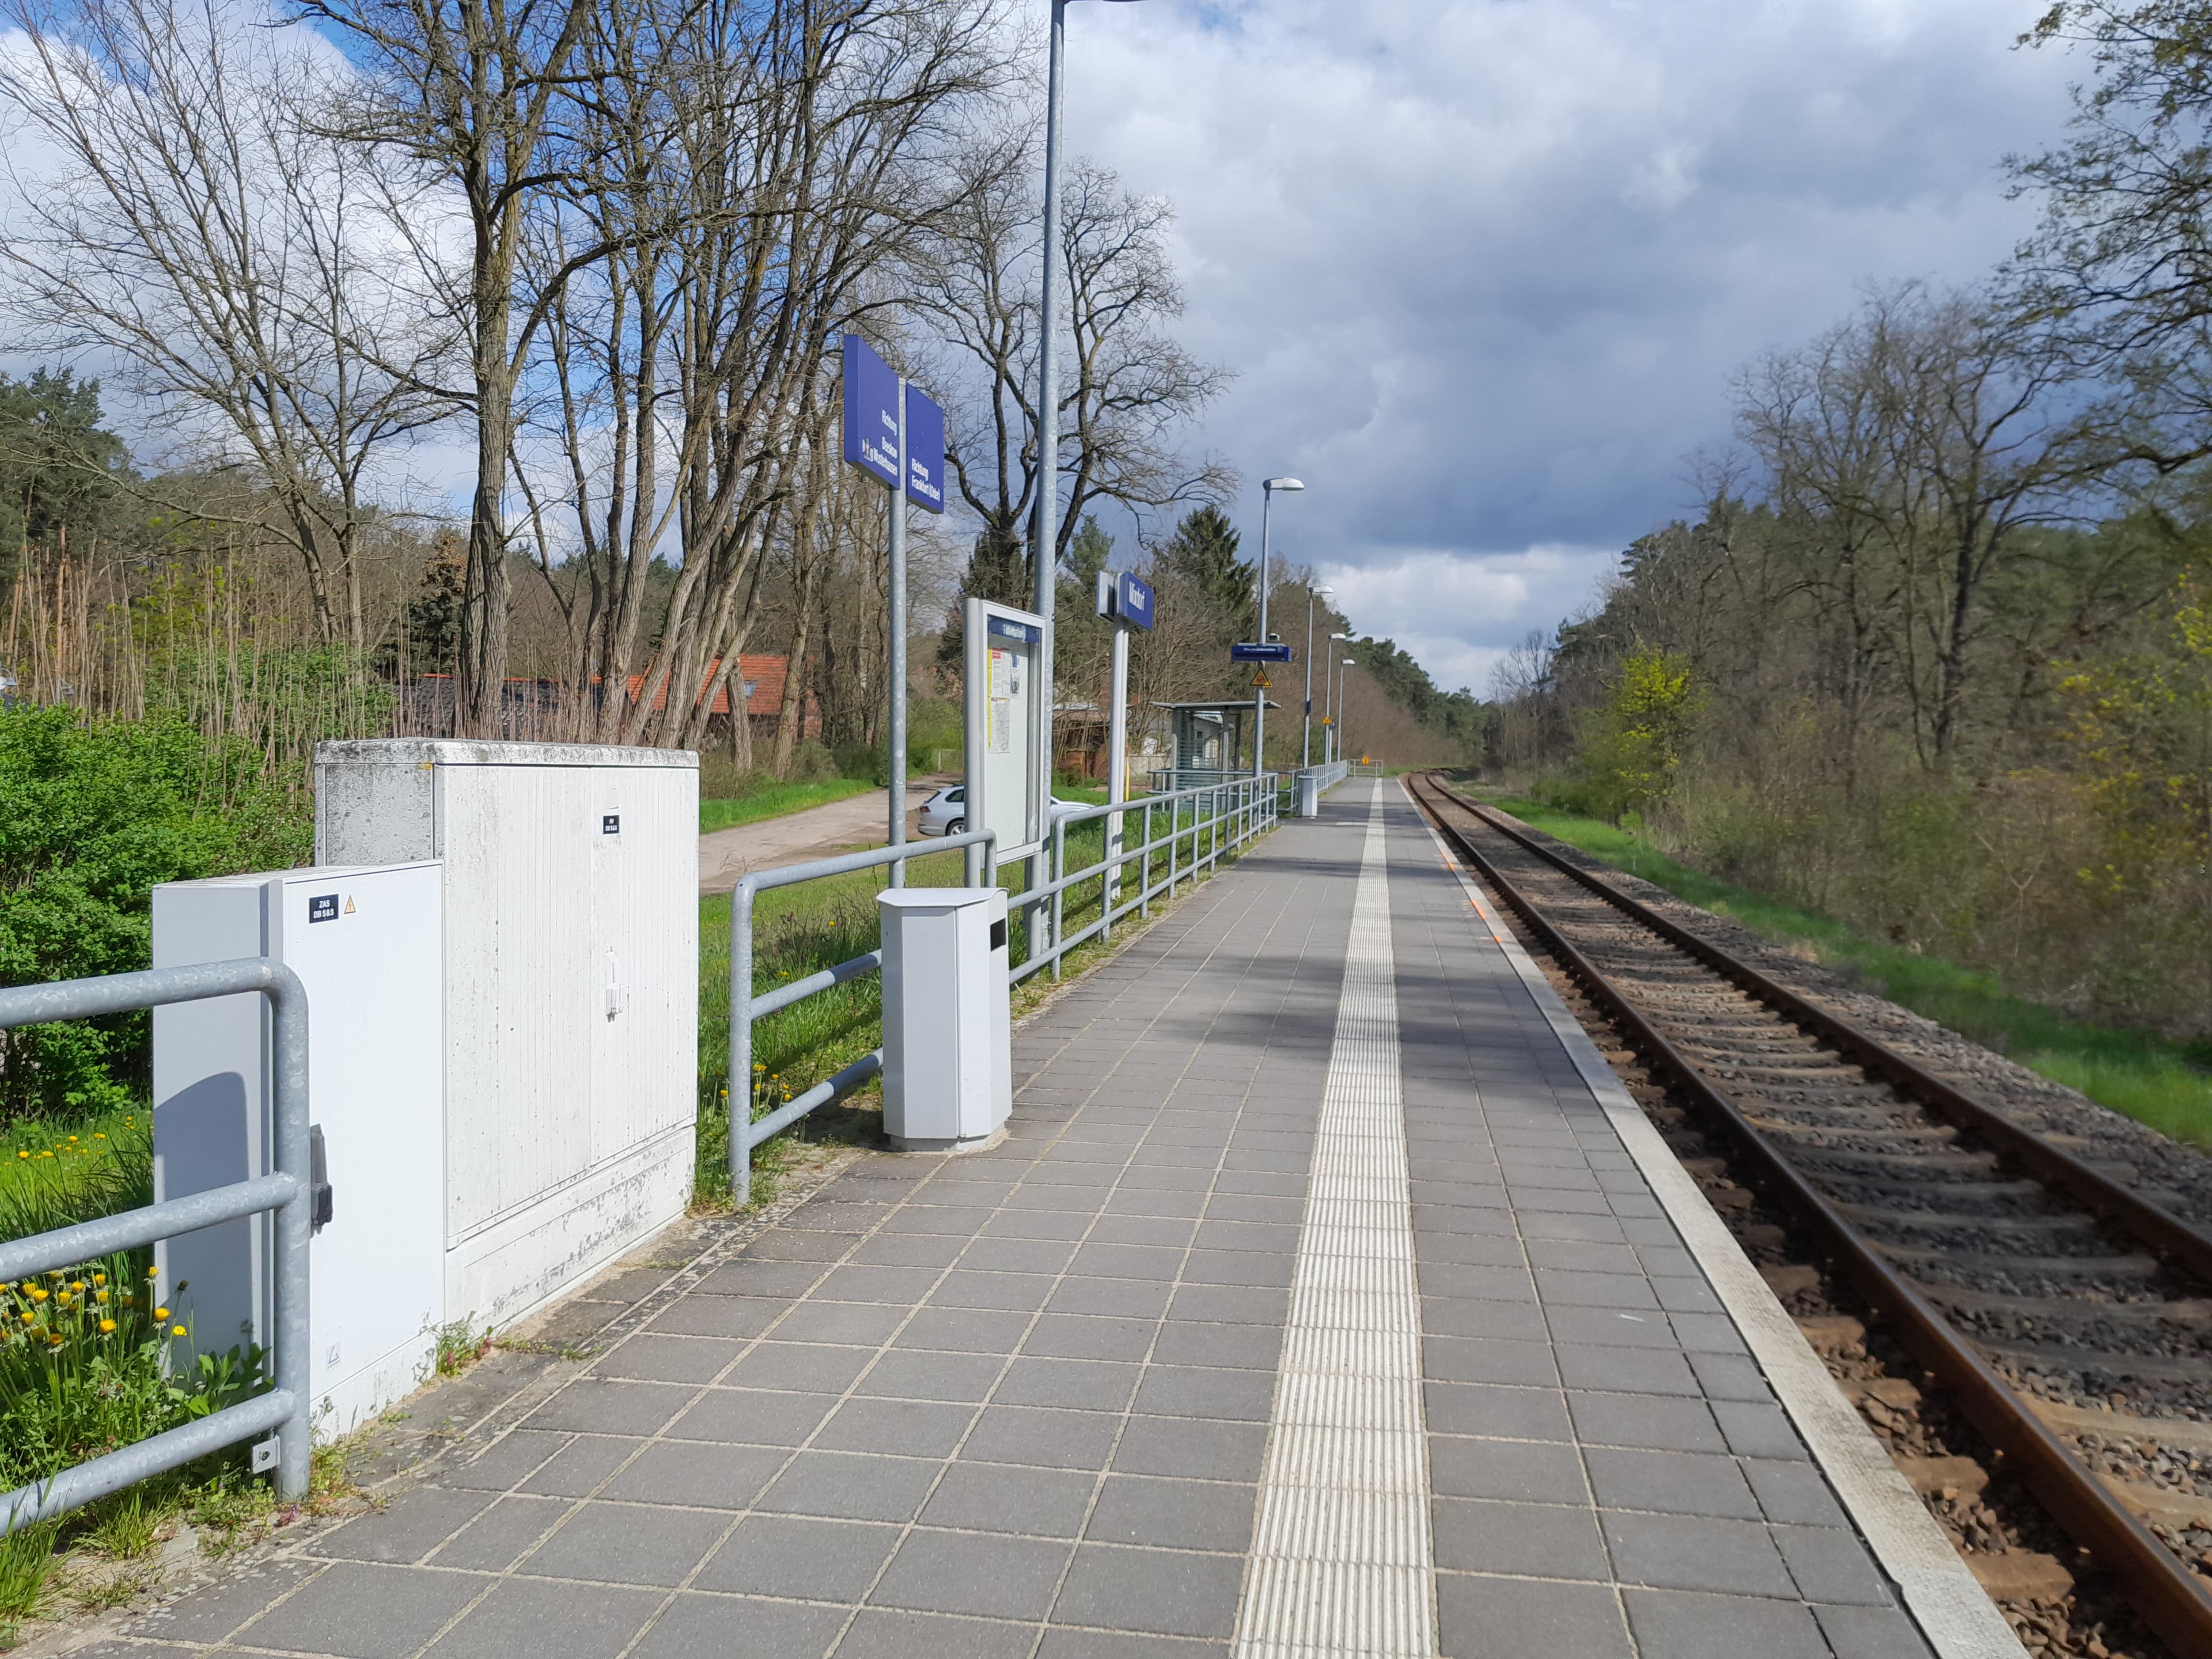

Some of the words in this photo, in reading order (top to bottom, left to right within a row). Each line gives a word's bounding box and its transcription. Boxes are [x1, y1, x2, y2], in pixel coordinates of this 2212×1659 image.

[882, 410, 897, 436] Richtung
[882, 436, 897, 459] Beeskow
[912, 457, 929, 481] Richtung
[912, 475, 929, 495] Frankfurt
[929, 483, 940, 502] (Oder)
[313, 911, 321, 919] DB
[323, 908, 334, 917] S&S
[319, 900, 330, 908] ZAS
